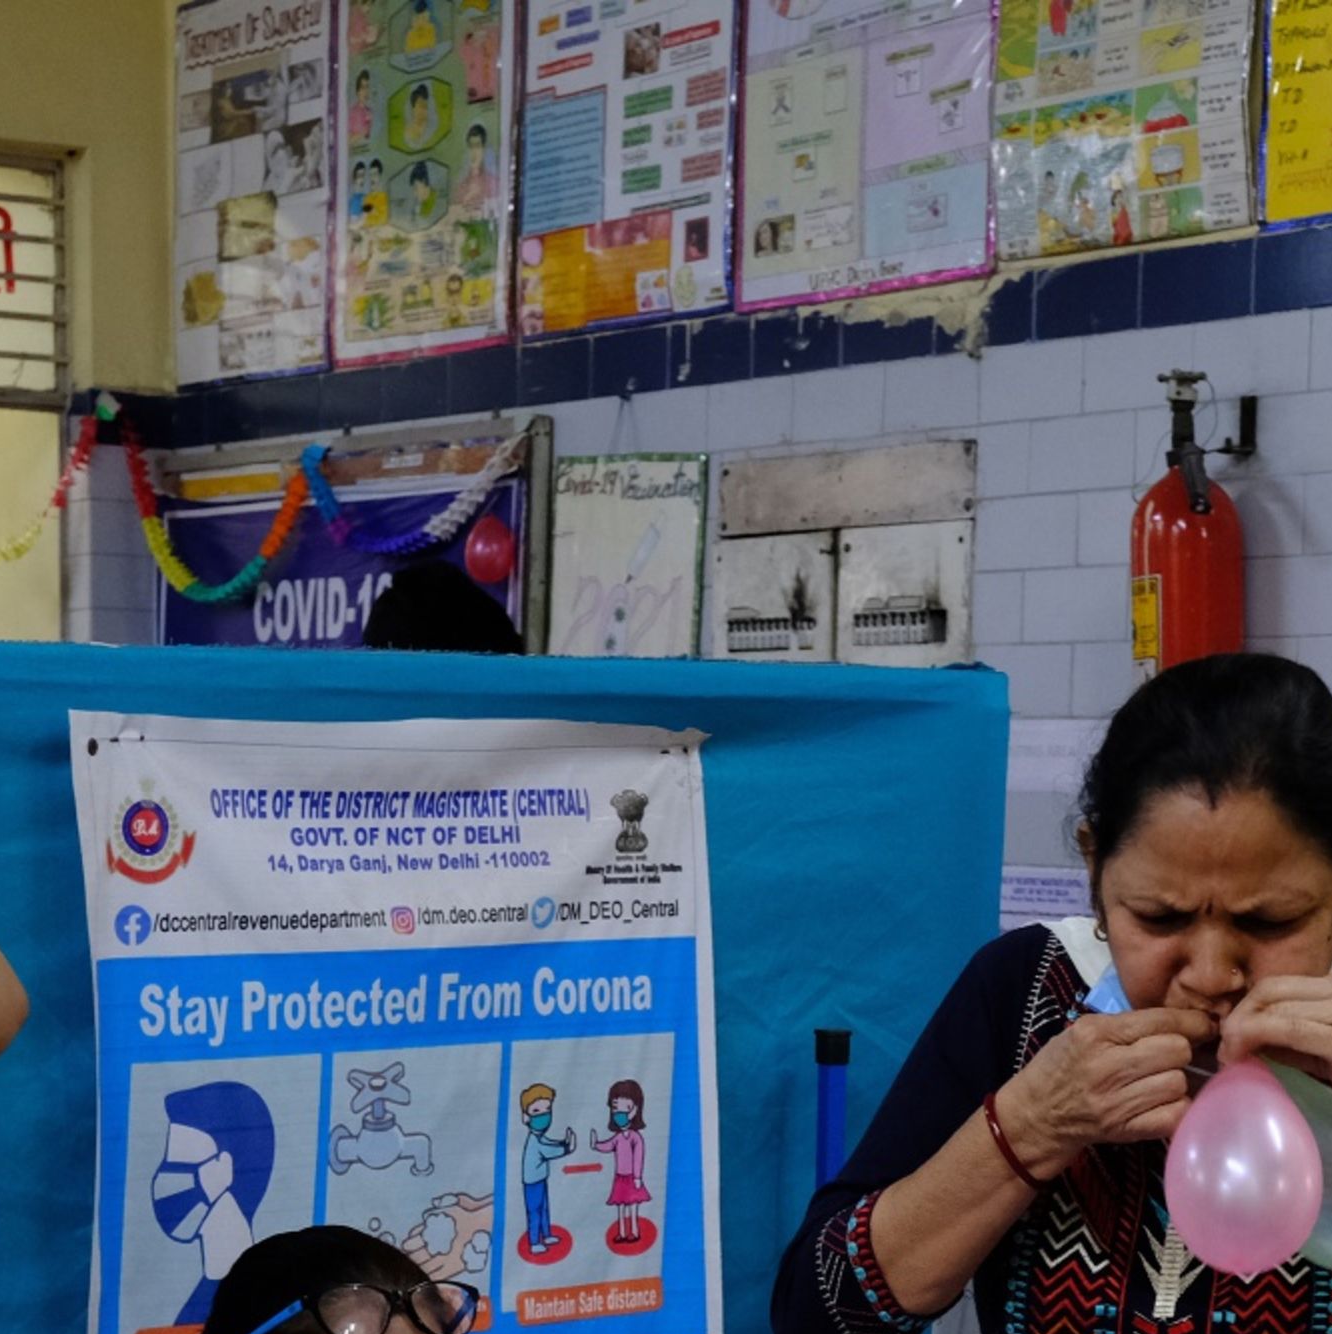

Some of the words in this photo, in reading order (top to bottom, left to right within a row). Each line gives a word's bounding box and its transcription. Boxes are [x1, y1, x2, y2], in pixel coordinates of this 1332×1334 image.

[210, 788, 267, 819] OFFICE
[272, 789, 293, 819] OF
[299, 790, 331, 819] THE
[335, 789, 410, 819] DISTRICT
[412, 788, 508, 818] MAGISTRATE
[513, 788, 590, 822] (CENTRAL)
[290, 827, 348, 847] GOVT.
[354, 827, 380, 846] OF
[387, 827, 426, 846] NCT
[432, 826, 457, 845] OF
[464, 825, 521, 844] DELHI
[268, 854, 293, 873] 14,
[298, 855, 345, 874] Darya
[350, 854, 392, 874] Ganj,
[397, 854, 433, 871] New
[439, 852, 479, 870] Delhi
[484, 851, 550, 868] -110002
[139, 983, 228, 1047] Stay
[242, 974, 427, 1032] Protected
[438, 972, 522, 1021] From
[533, 966, 652, 1017] Corona
[524, 1293, 575, 1321] Maintain
[579, 1291, 603, 1315] Safe
[607, 1287, 657, 1311] distance
